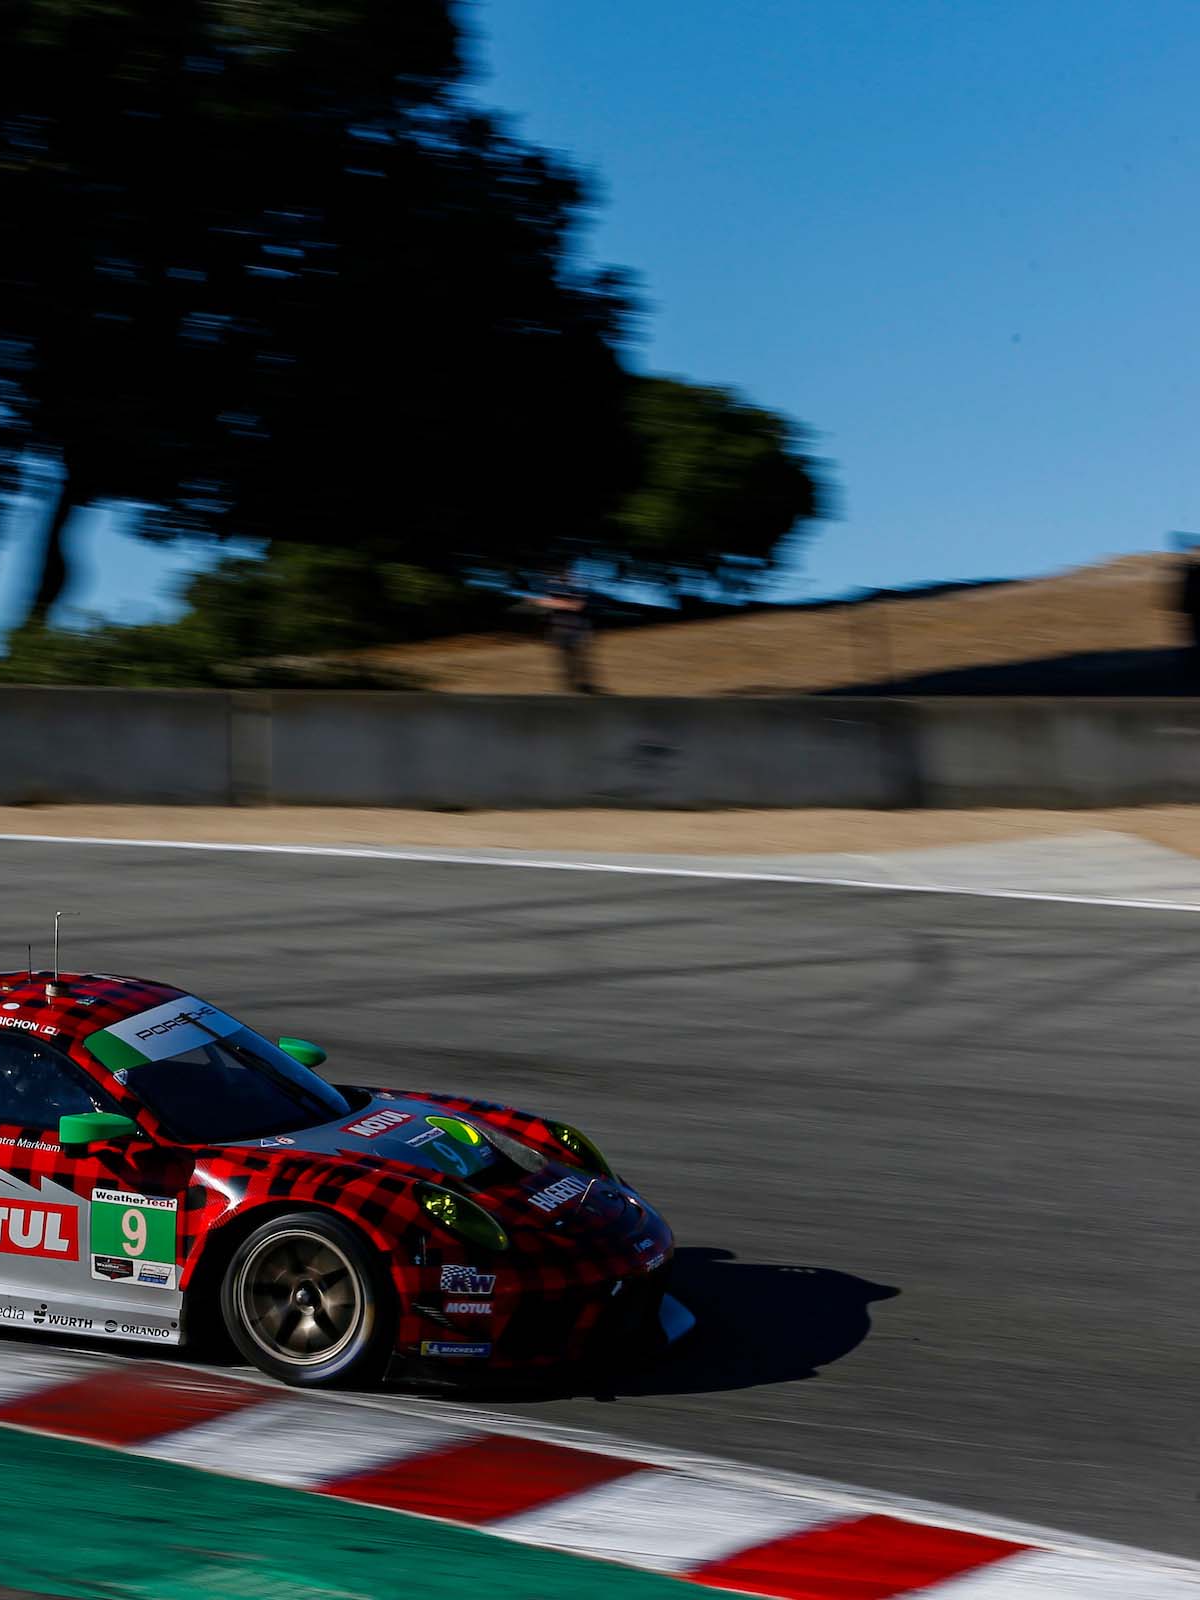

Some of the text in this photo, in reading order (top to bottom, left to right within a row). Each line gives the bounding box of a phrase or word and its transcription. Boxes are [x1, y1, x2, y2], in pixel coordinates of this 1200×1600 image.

[135, 1006, 216, 1041] PORSCHE
[347, 1110, 412, 1137] MOTUL
[16, 1138, 61, 1153] Markham
[432, 1141, 468, 1177] 9
[95, 1191, 174, 1209] WeatherTech
[527, 1175, 588, 1212] HAGERTY
[121, 1208, 147, 1257] 9
[446, 1302, 492, 1314] MOTUL
[121, 1324, 170, 1338] ORLANDO
